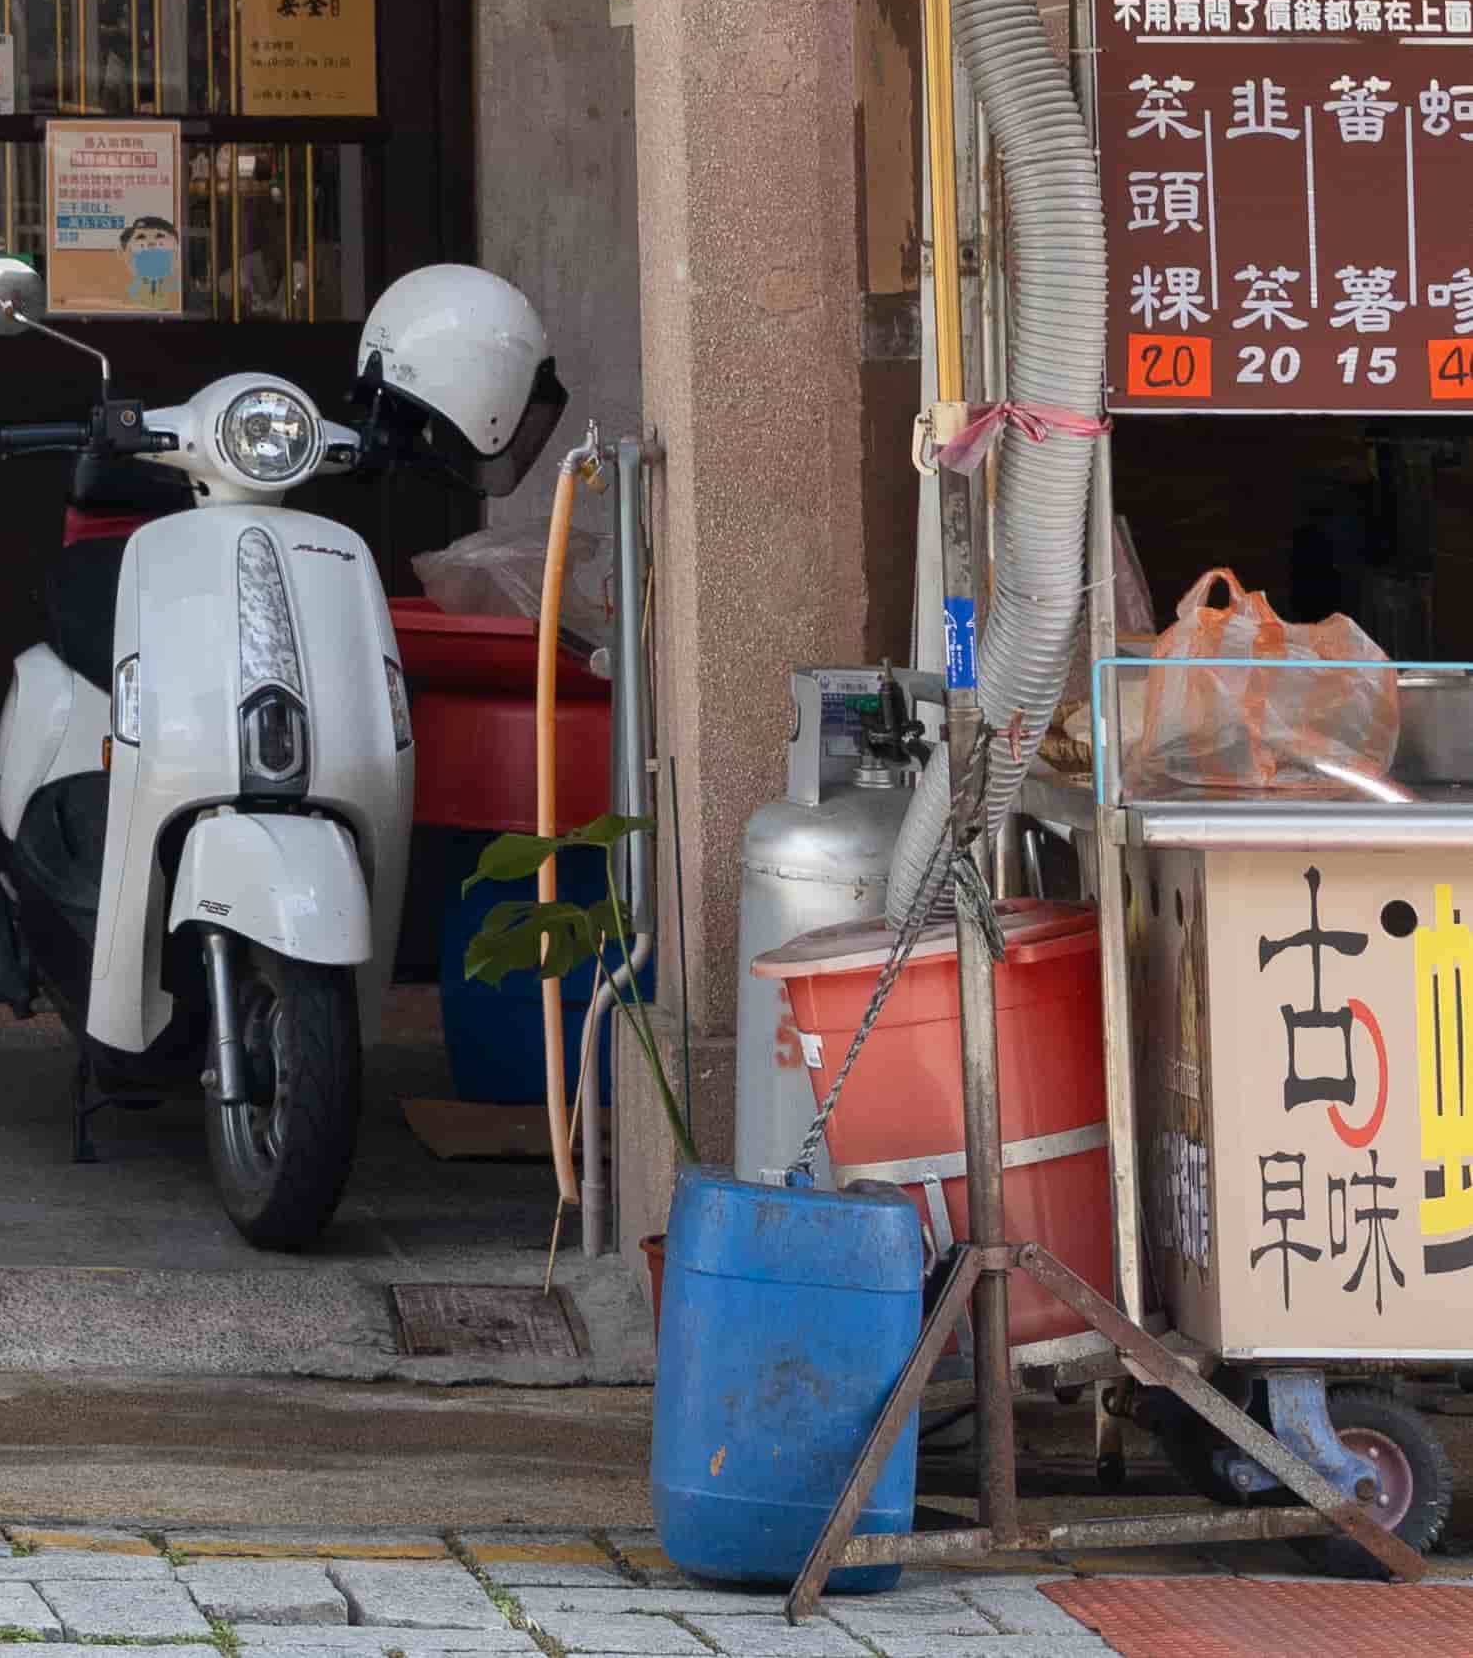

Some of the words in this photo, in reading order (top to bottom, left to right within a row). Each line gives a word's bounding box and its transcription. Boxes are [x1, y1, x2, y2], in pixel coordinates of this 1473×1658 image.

[1126, 73, 1211, 331] 菜頭粿
[1225, 77, 1309, 331] 韭菜
[1323, 74, 1407, 333] 蕃薯
[1141, 343, 1196, 388] 20
[1236, 345, 1301, 384] 20
[1336, 346, 1398, 385] 15
[1438, 346, 1473, 387] 4
